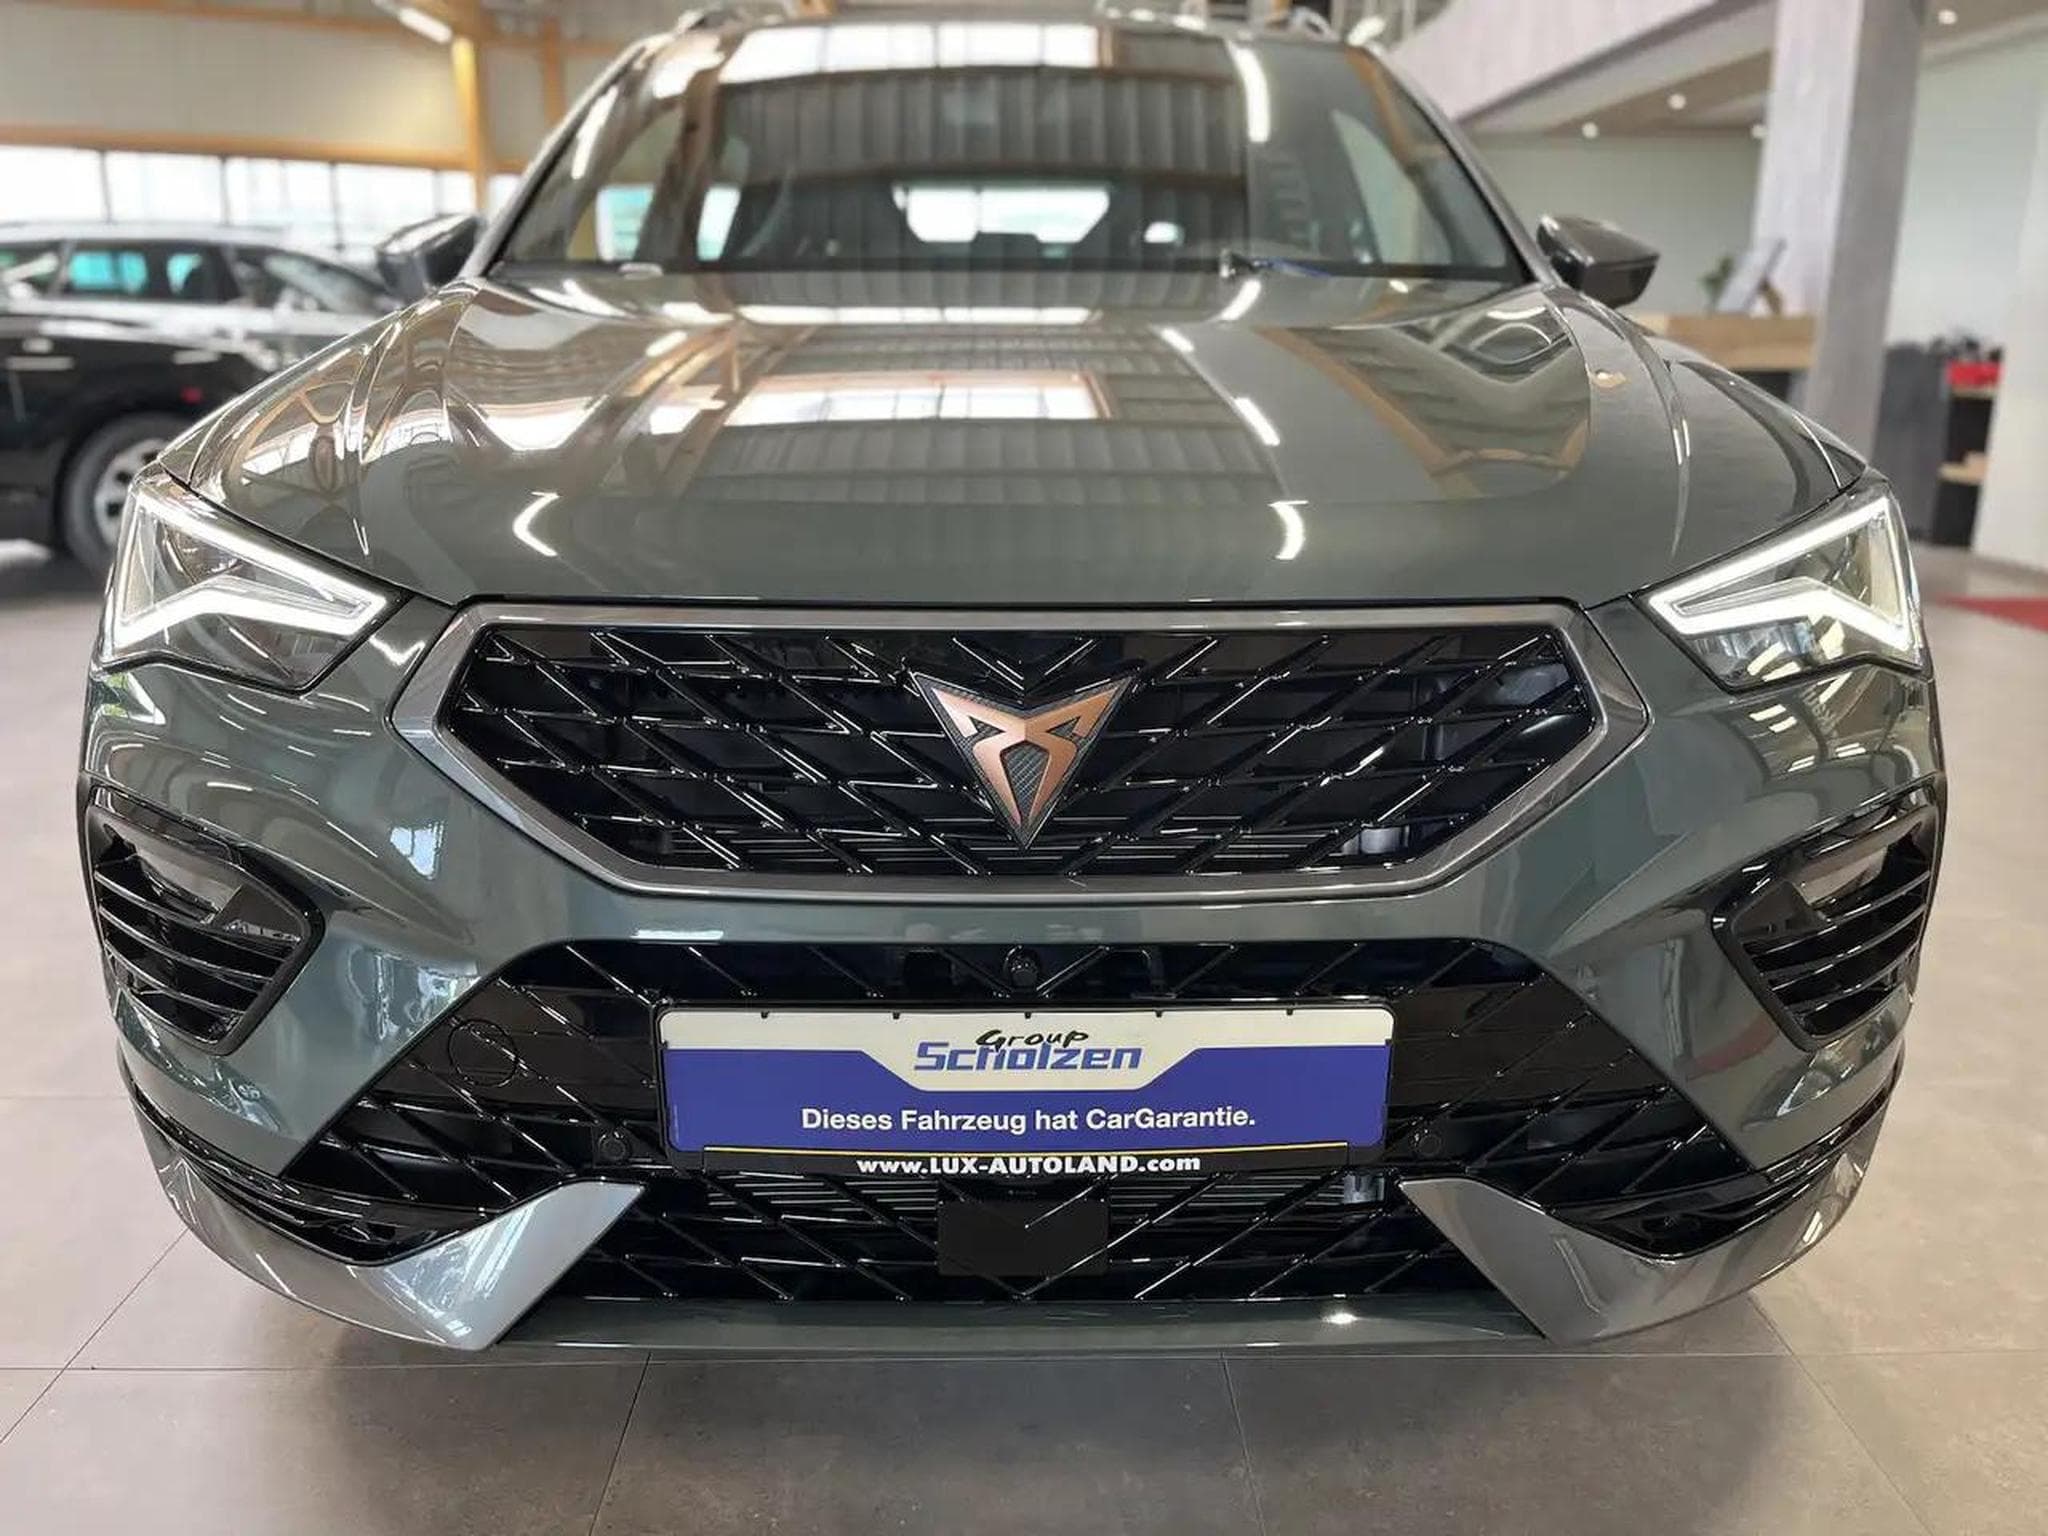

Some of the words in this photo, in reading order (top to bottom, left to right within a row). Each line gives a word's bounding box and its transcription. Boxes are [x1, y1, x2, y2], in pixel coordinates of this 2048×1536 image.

[975, 1029, 1090, 1051] Group
[914, 1041, 1143, 1071] Scholzen
[802, 1108, 893, 1131] Dieses
[901, 1110, 1026, 1135] Fahrzeug
[1035, 1110, 1078, 1131] hat
[1085, 1106, 1256, 1130] CarGarantie.
[857, 1155, 1201, 1175] www.LUX-AUTOLAND.com
